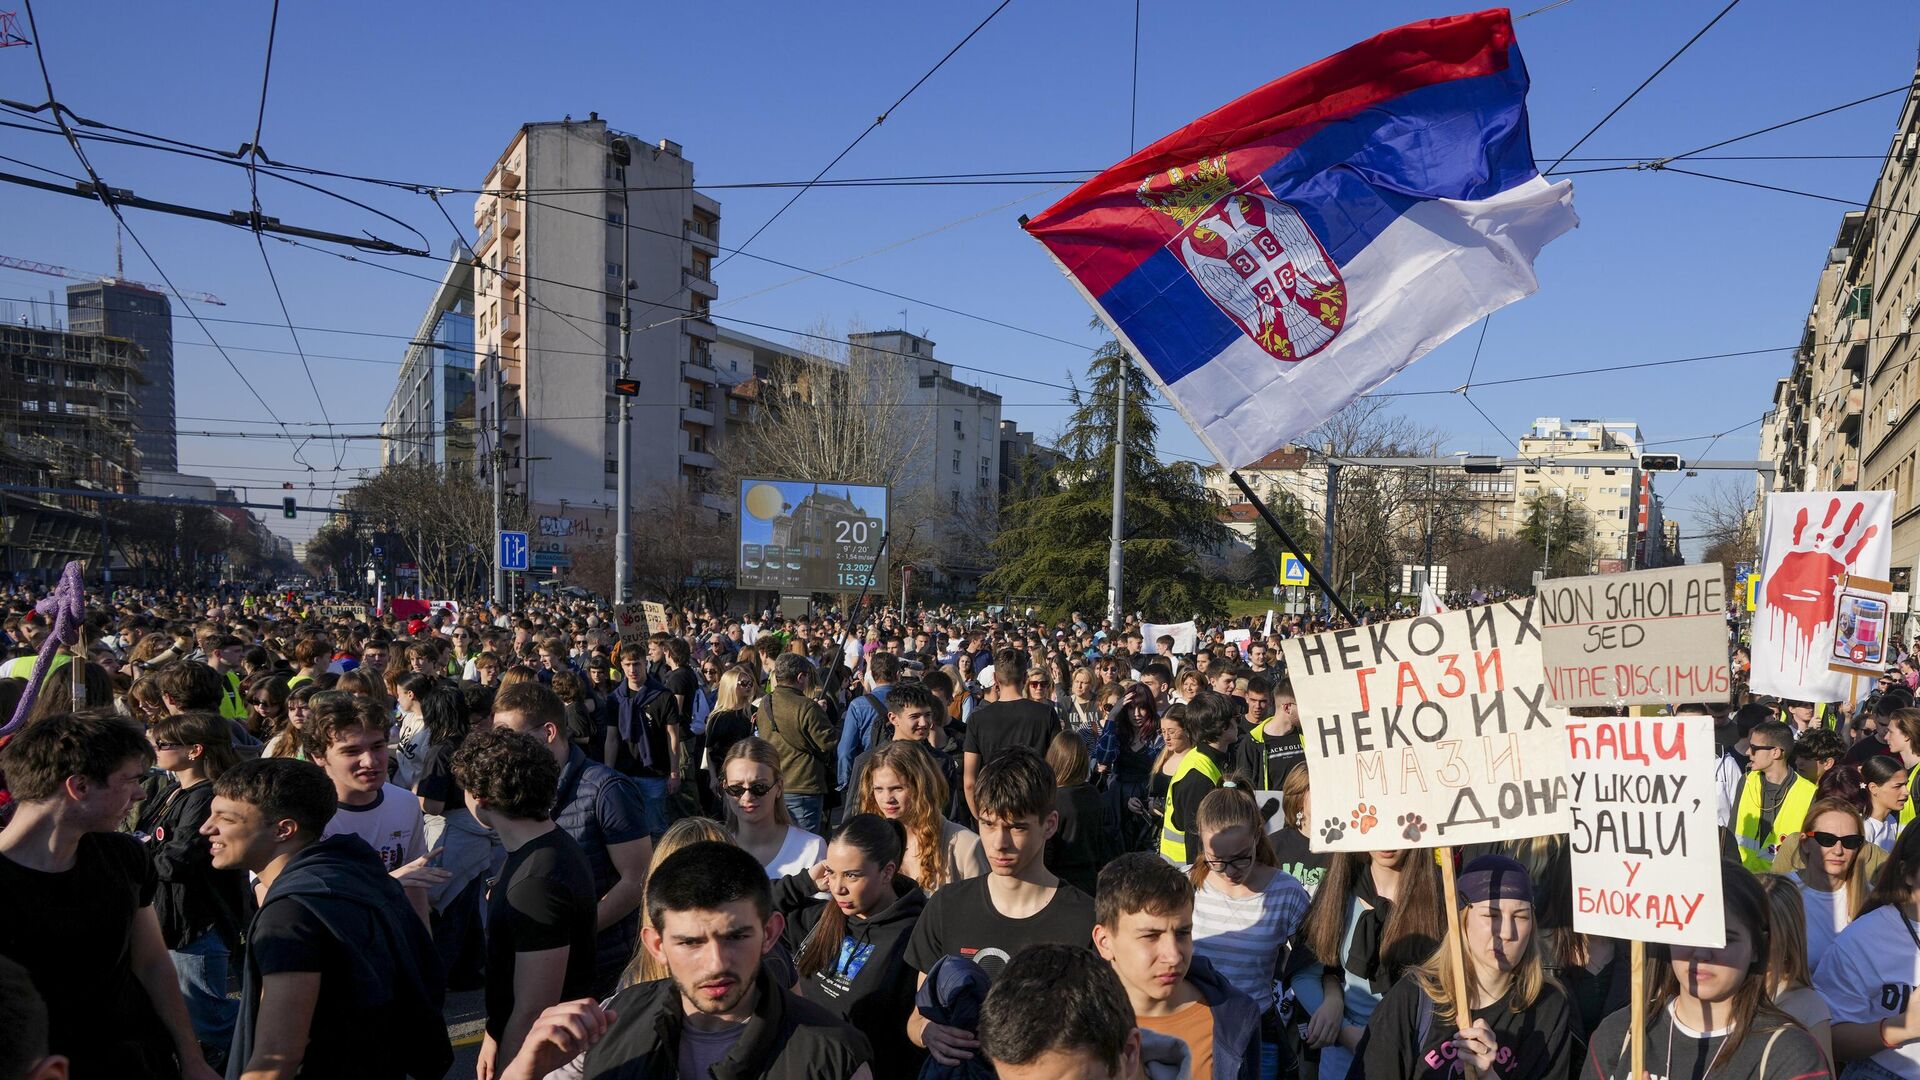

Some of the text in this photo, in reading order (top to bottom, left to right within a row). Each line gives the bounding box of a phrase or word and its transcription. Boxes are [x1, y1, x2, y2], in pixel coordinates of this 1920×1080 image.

[835, 520, 877, 544] 20°
[1540, 578, 1721, 626] NON SCHOLAE
[1300, 600, 1541, 676] НЕКО ИХ
[1583, 623, 1645, 653] SED
[1356, 648, 1504, 712] ГАЗИ
[1544, 664, 1728, 701] VITAE DISCIMUS
[1317, 683, 1552, 758] НЕКО ИХ
[1565, 720, 1687, 766] ЋАЦИ
[1354, 732, 1522, 799] МАЗИ
[1571, 771, 1701, 813] У ШКОЛУ,
[1570, 806, 1687, 859] ЂАЦИ
[1623, 860, 1641, 887] У
[1578, 887, 1705, 931] БЛОКАДУ
